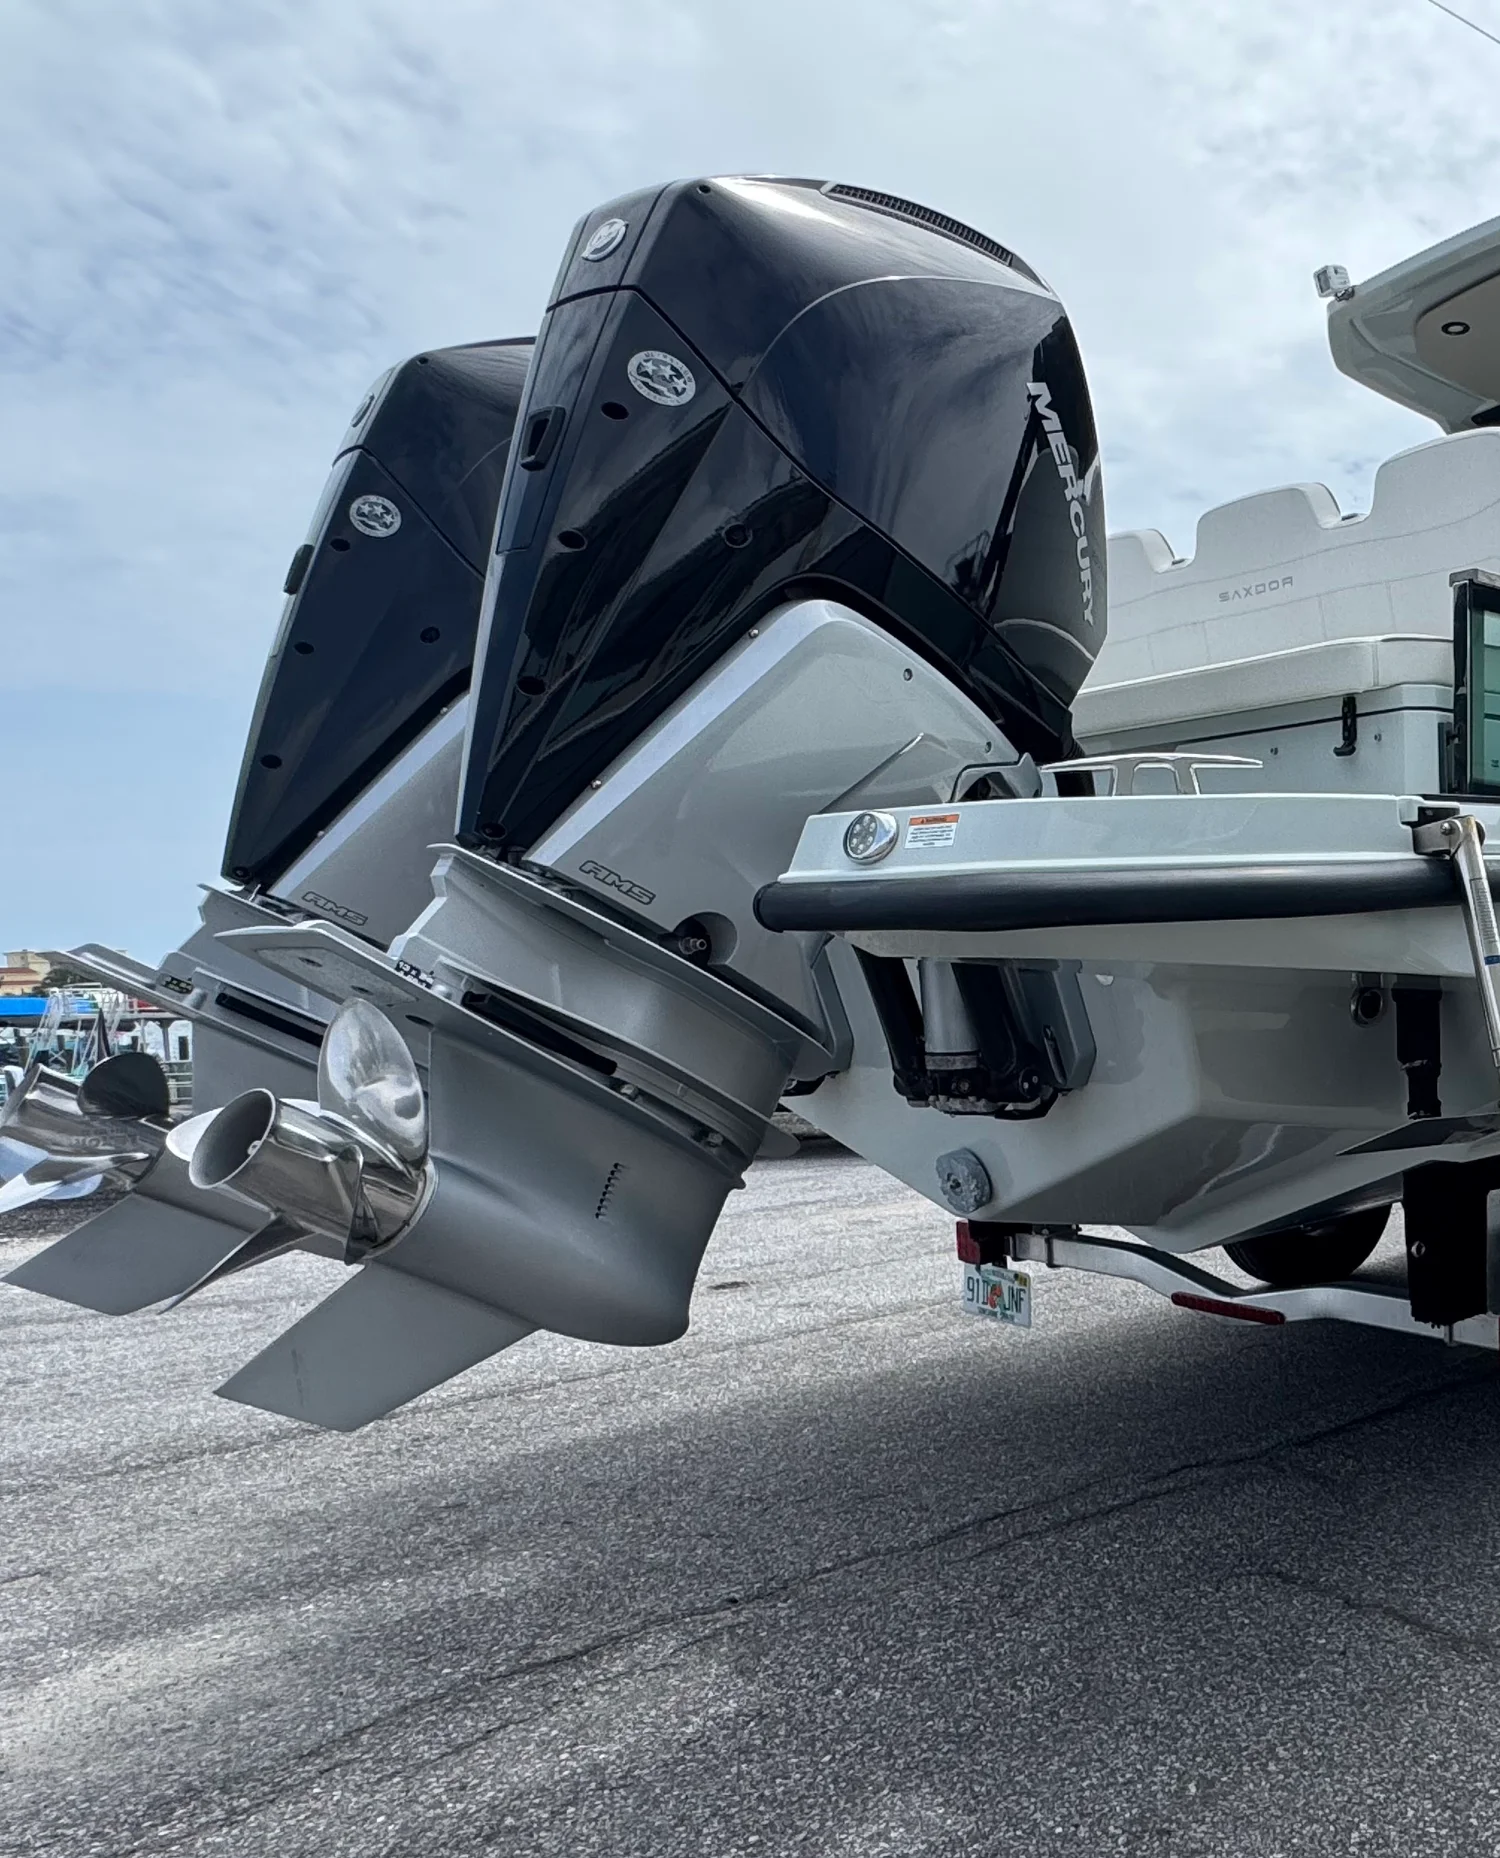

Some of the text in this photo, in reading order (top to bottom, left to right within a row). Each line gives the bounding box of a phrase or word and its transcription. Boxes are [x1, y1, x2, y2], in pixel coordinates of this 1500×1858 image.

[1026, 381, 1095, 626] MERCURY
[1218, 576, 1294, 602] SAXDOR
[579, 860, 656, 905] AMS
